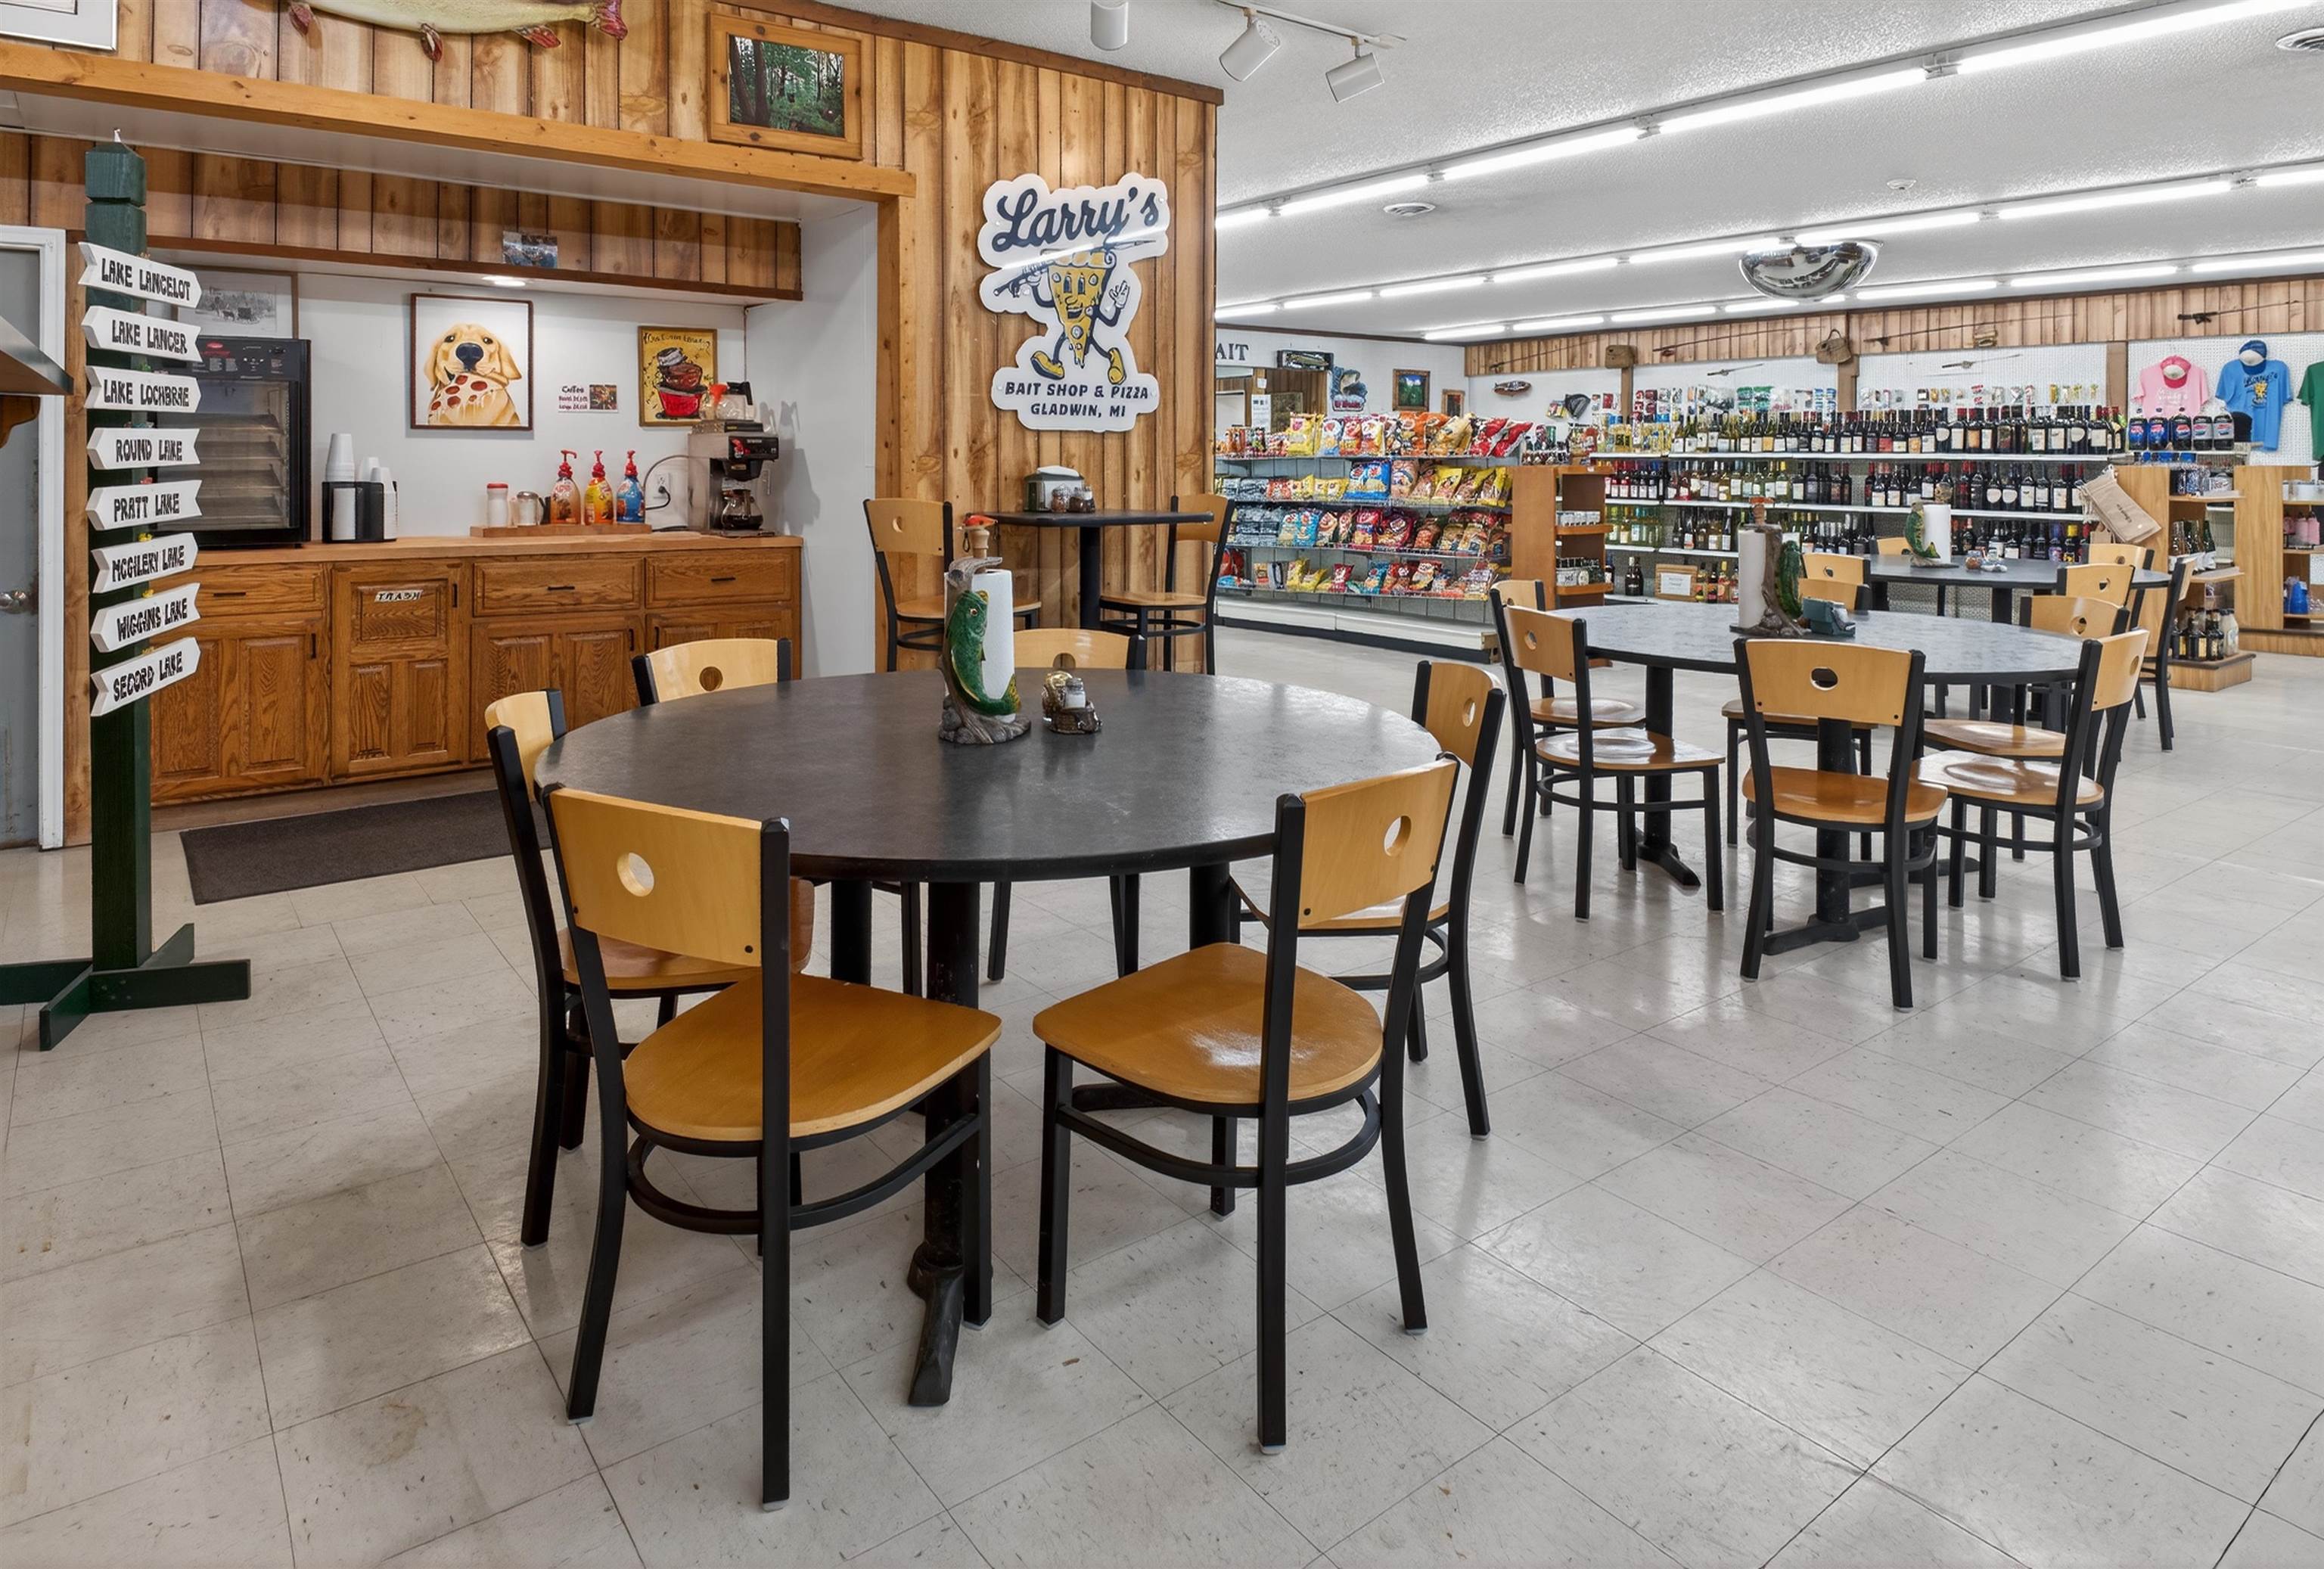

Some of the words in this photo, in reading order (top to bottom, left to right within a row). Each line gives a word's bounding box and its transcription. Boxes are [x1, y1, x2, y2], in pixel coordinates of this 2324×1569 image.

[991, 187, 1159, 252] Larry's
[101, 258, 133, 287] LAKE
[139, 269, 191, 301] LANCELOT
[112, 319, 141, 346] LAKE
[147, 326, 188, 354] LANCER
[104, 379, 133, 404] LAKE
[1005, 381, 1041, 396] BAIT
[1047, 384, 1088, 397] SHOP
[1094, 385, 1105, 398] &
[1111, 386, 1148, 399] PIZZA
[1030, 403, 1102, 419] GLADWIN,
[116, 439, 152, 462] ROUND
[158, 440, 182, 461] LAKE
[114, 496, 148, 522] PRATT
[155, 493, 180, 516] LAKE
[162, 545, 185, 570] LAKE
[117, 606, 161, 642] WIGGINS
[164, 598, 188, 625] LAKE
[113, 666, 154, 702] SECORD
[159, 651, 183, 682] LAKE
